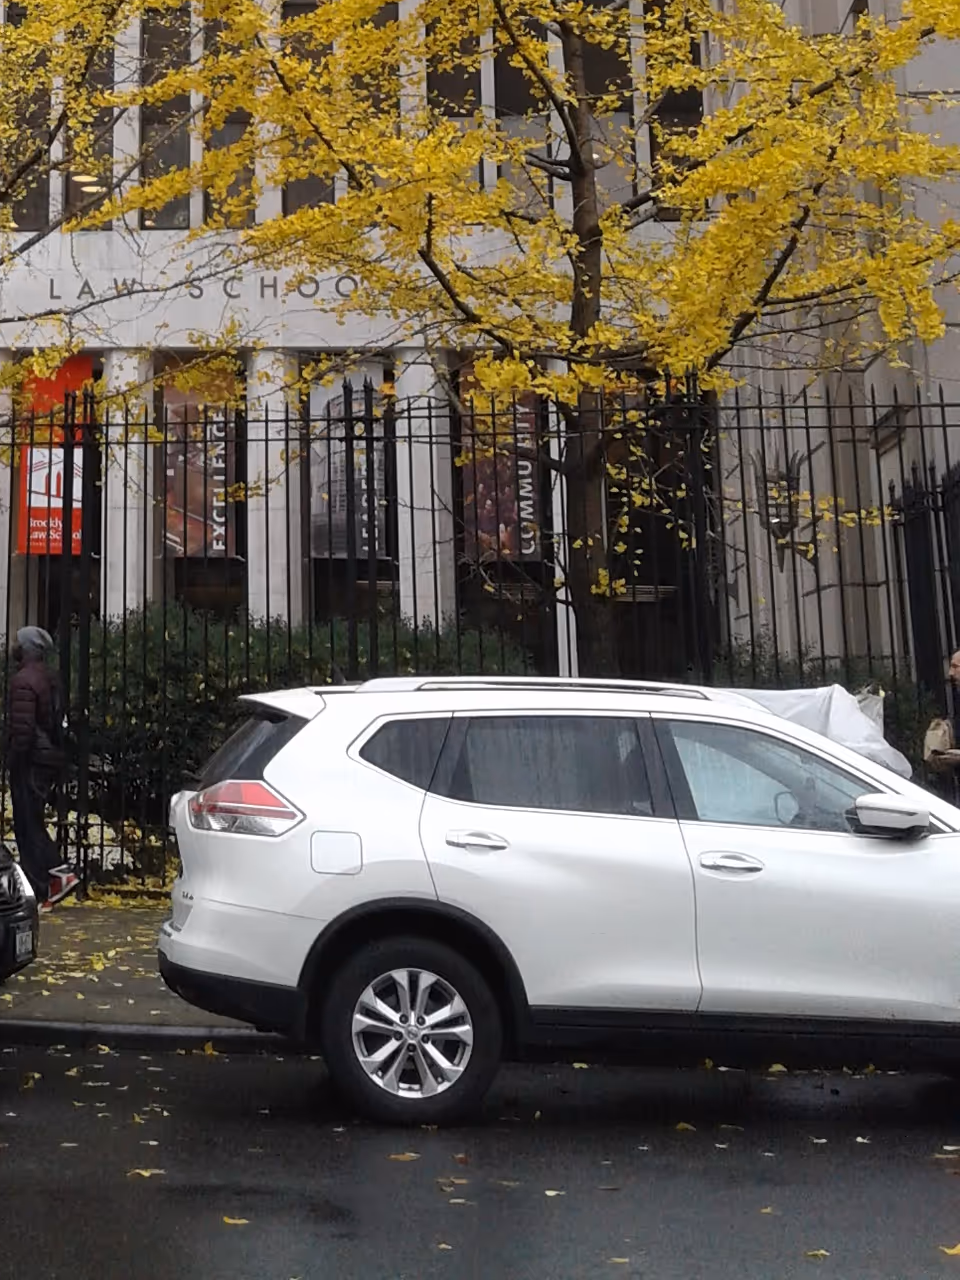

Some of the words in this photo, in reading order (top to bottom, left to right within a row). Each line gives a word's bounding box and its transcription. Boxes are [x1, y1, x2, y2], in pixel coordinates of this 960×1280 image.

[49, 277, 136, 300] LAW
[189, 275, 391, 299] SCHOO
[515, 404, 536, 554] COMMUITY
[49, 529, 82, 540] Scol
